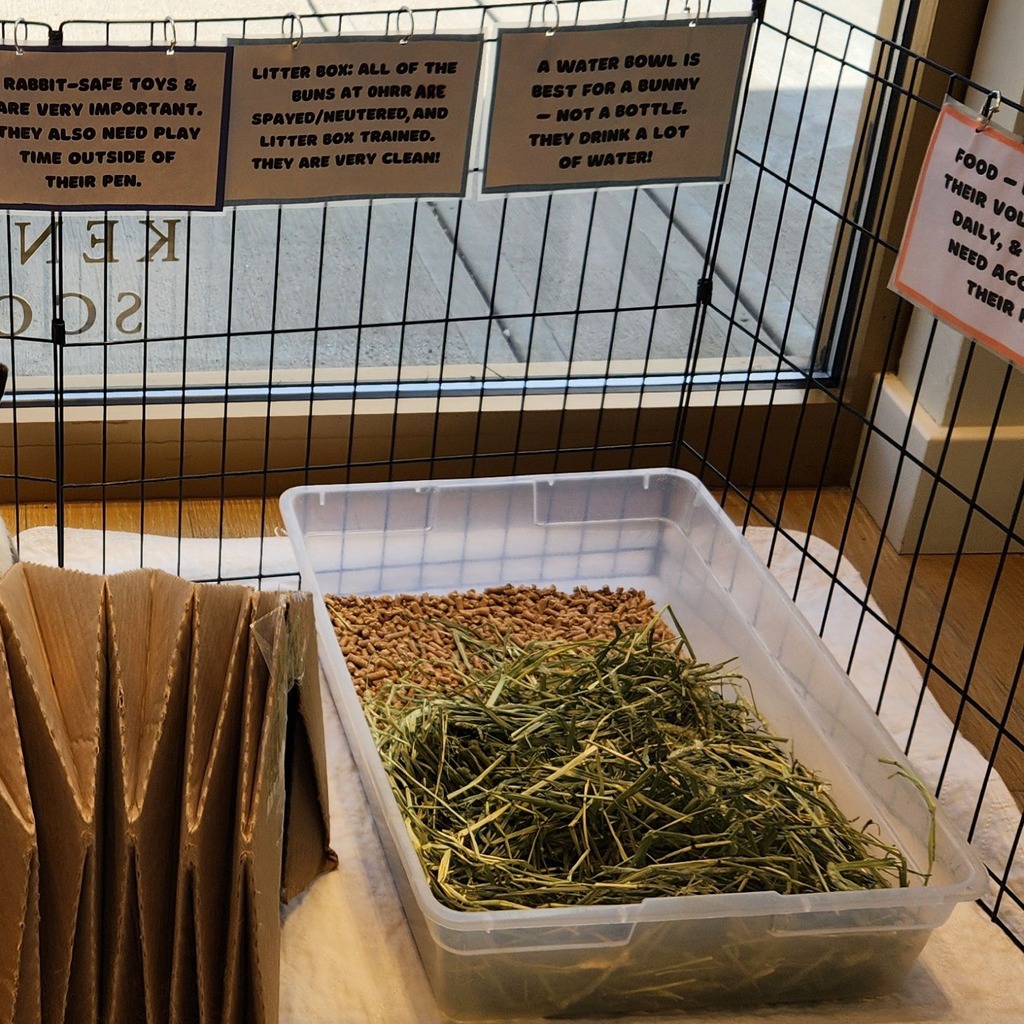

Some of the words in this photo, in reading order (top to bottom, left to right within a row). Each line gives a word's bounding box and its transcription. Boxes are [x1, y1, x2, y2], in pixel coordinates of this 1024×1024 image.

[252, 66, 310, 79] LITTER
[316, 64, 353, 78] BOX:
[358, 63, 390, 75] ALL
[396, 62, 419, 74] OF
[425, 61, 458, 74] THE
[537, 60, 549, 73] A
[557, 57, 619, 73] WATER
[624, 54, 677, 68] BOWL
[684, 53, 700, 66] IS
[130, 78, 177, 91] TOYS
[184, 79, 196, 91] &
[292, 87, 335, 102] BUNS
[340, 86, 363, 99] AT
[414, 84, 446, 99] ARE
[532, 84, 577, 98] BEST
[582, 82, 615, 96] FOR
[621, 80, 632, 93] A
[638, 77, 700, 92] BUNNY
[37, 103, 83, 116] VERY
[89, 102, 203, 116] IMPORTANT.
[556, 108, 594, 122] NOT
[599, 107, 610, 119] A
[615, 102, 687, 117] BOTTLE.
[48, 127, 96, 140] ALSO
[102, 127, 147, 139] NEED
[154, 127, 200, 140] PLAY
[260, 134, 317, 147] LITTER
[323, 132, 354, 145] BOX
[360, 130, 435, 143] TRAINED.
[529, 133, 574, 146] THEY
[579, 128, 630, 144] DRINK
[636, 127, 647, 140] A
[653, 125, 689, 139] LOT
[20, 151, 62, 164] TIME
[68, 151, 145, 164] OUTSIDE
[152, 151, 175, 163] OF
[252, 157, 294, 169] THEY
[299, 156, 330, 168] ARE
[335, 153, 376, 166] VERY
[382, 152, 440, 164] CLEAN!
[559, 156, 582, 169] OF
[587, 151, 653, 167] WATER!
[955, 148, 998, 180] FOOD
[45, 175, 95, 188] THEIR
[102, 175, 141, 187] PEN.
[944, 174, 987, 208] THEIR
[952, 210, 1002, 251] DAILY,
[1009, 240, 1022, 257] &
[948, 239, 988, 270] NEED
[967, 279, 1014, 316] THEIR
